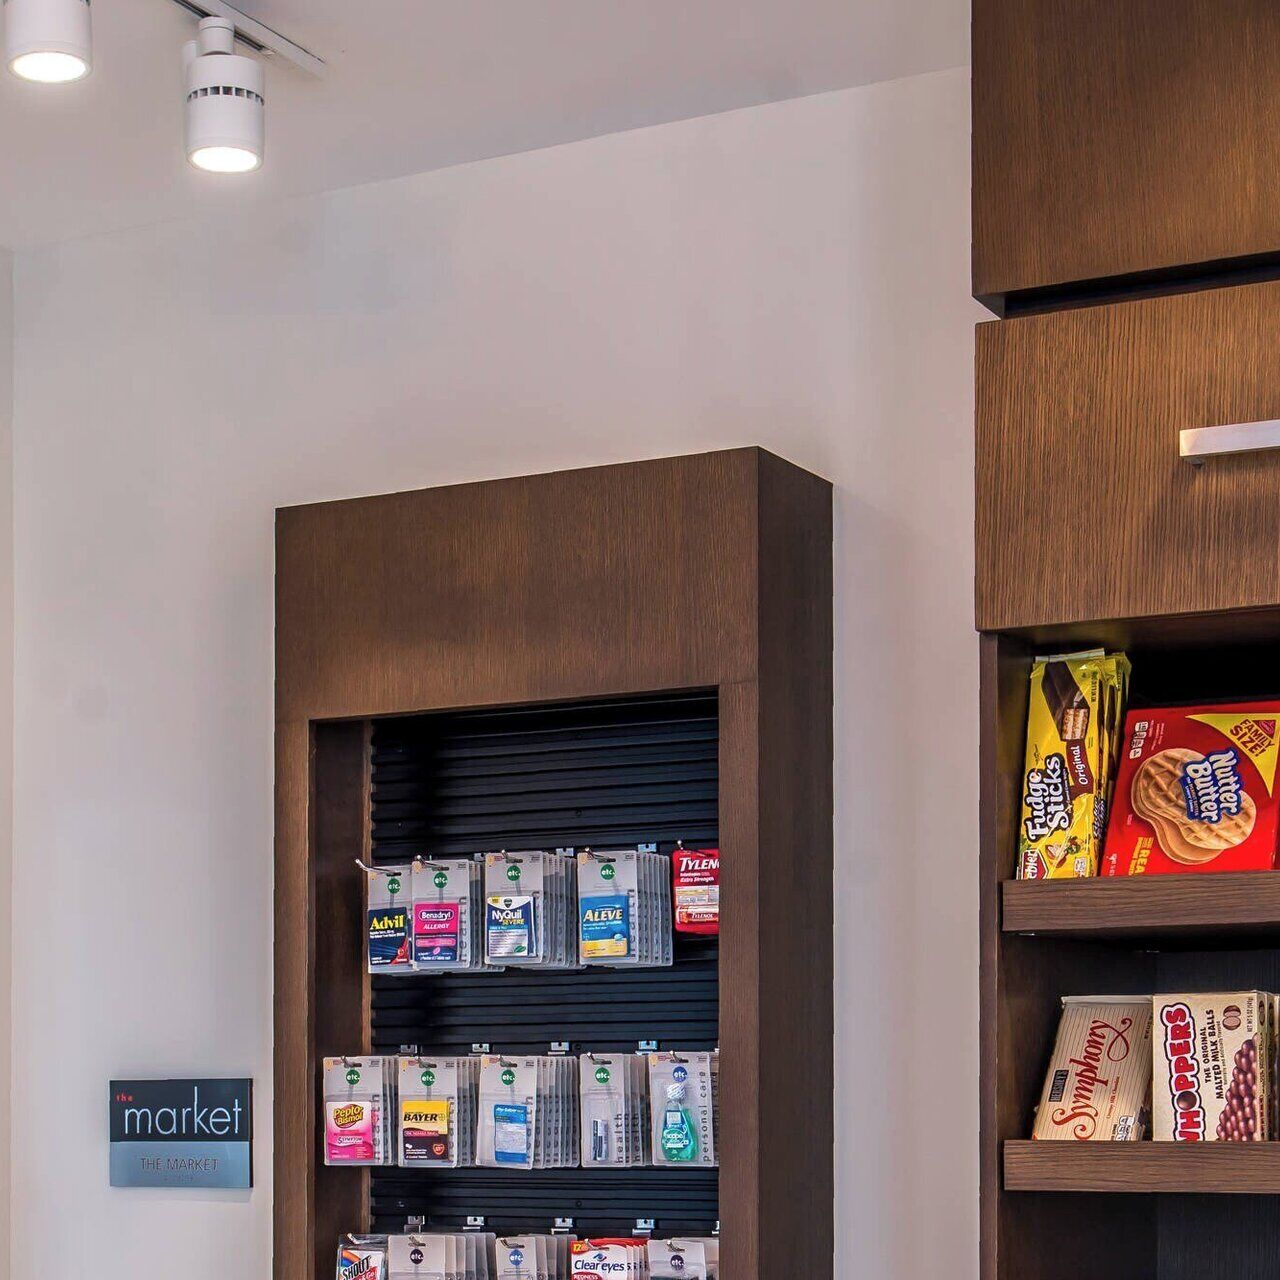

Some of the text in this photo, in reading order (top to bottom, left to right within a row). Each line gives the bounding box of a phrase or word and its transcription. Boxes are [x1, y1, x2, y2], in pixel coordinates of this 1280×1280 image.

[1230, 725, 1267, 757] SIZE!
[1239, 718, 1275, 748] FAMILY
[1071, 745, 1088, 786] Original
[1213, 750, 1238, 815] Nutter
[1026, 771, 1050, 838] Fudge
[1047, 756, 1069, 829] Sticks
[1188, 761, 1219, 822] Butter
[680, 857, 719, 871] TYLEN
[370, 914, 405, 930] Advil
[421, 911, 451, 921] Benadryl
[492, 909, 521, 921] NyQuil
[583, 909, 622, 922] ALEVE
[1200, 1027, 1209, 1064] ORIGINAL
[1206, 1009, 1223, 1099] MALTED MILK BALLS
[1052, 1017, 1132, 1141] Symphony
[115, 1092, 133, 1102] the
[125, 1086, 242, 1135] market
[404, 1114, 437, 1122] BAYER
[699, 1071, 711, 1162] personal care
[615, 1113, 623, 1164] health
[141, 1158, 218, 1170] THE MARKET
[574, 1259, 625, 1274] Clear eyes
